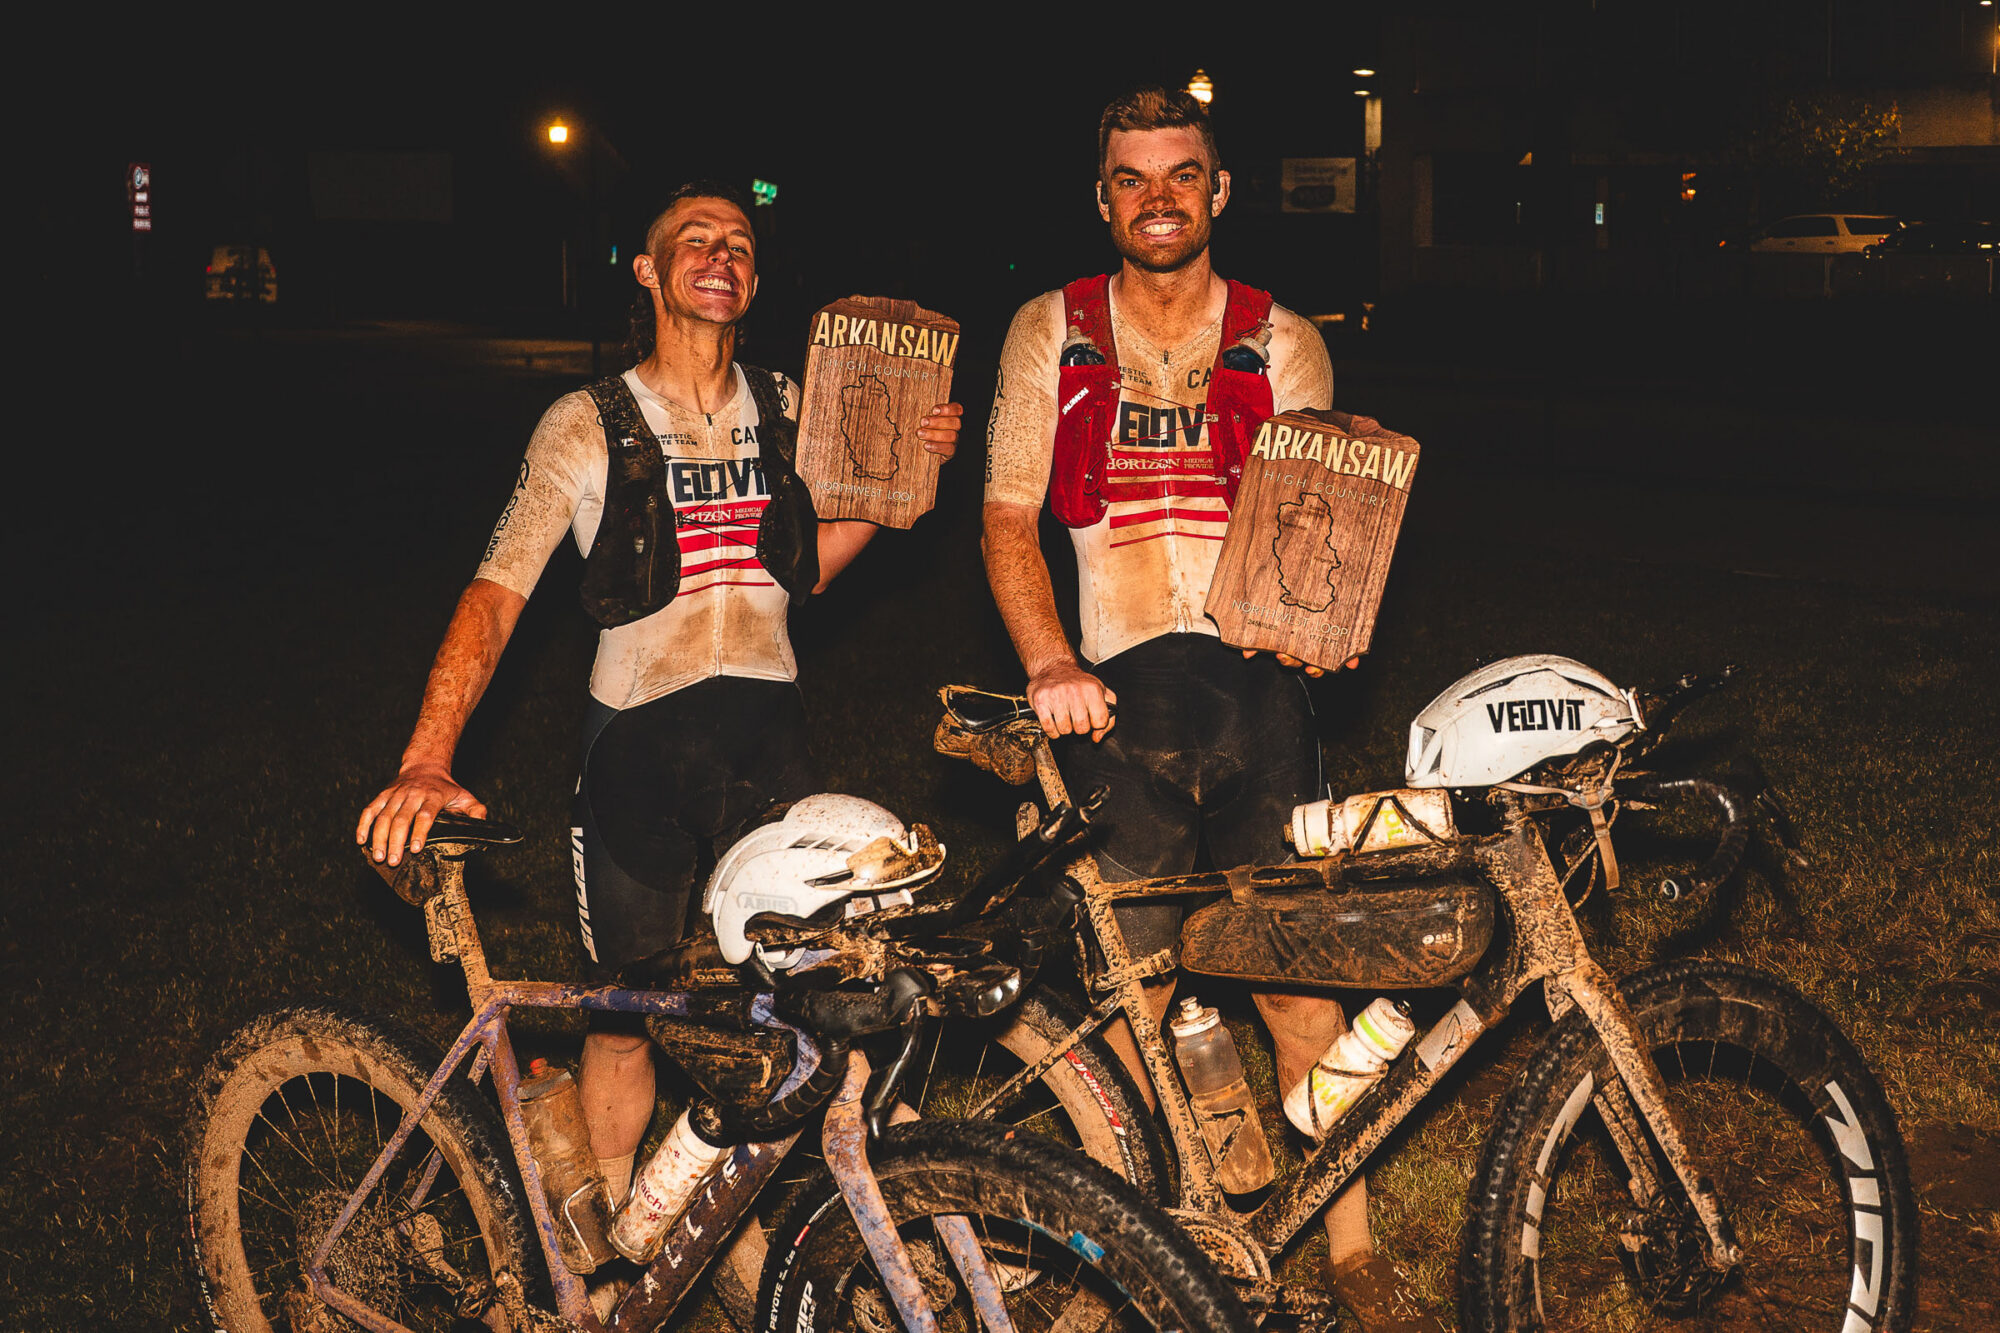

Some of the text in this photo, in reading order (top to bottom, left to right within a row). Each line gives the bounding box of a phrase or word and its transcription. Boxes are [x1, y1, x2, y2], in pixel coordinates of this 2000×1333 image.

[813, 311, 960, 368] ARKANSAW
[827, 358, 939, 382] HIGH COUNTRY
[1129, 375, 1153, 387] TEAM
[1187, 367, 1213, 389] CA
[1062, 387, 1090, 416] SALOMON
[675, 439, 698, 447] TEAM
[1251, 421, 1417, 490] ARKANSAW
[815, 479, 882, 498] NORTHWEST
[887, 489, 917, 502] LOOP
[1264, 470, 1388, 508] HIGH COUNTRY
[483, 495, 519, 563] CYCLING
[1231, 599, 1310, 628] NORTHWEST
[1316, 619, 1349, 636] LOOP
[1486, 698, 1586, 734] VELOVIT
[743, 897, 791, 913] ABUS
[1824, 1079, 1885, 1333] ZIP
[769, 1282, 784, 1331] PEYOTE
